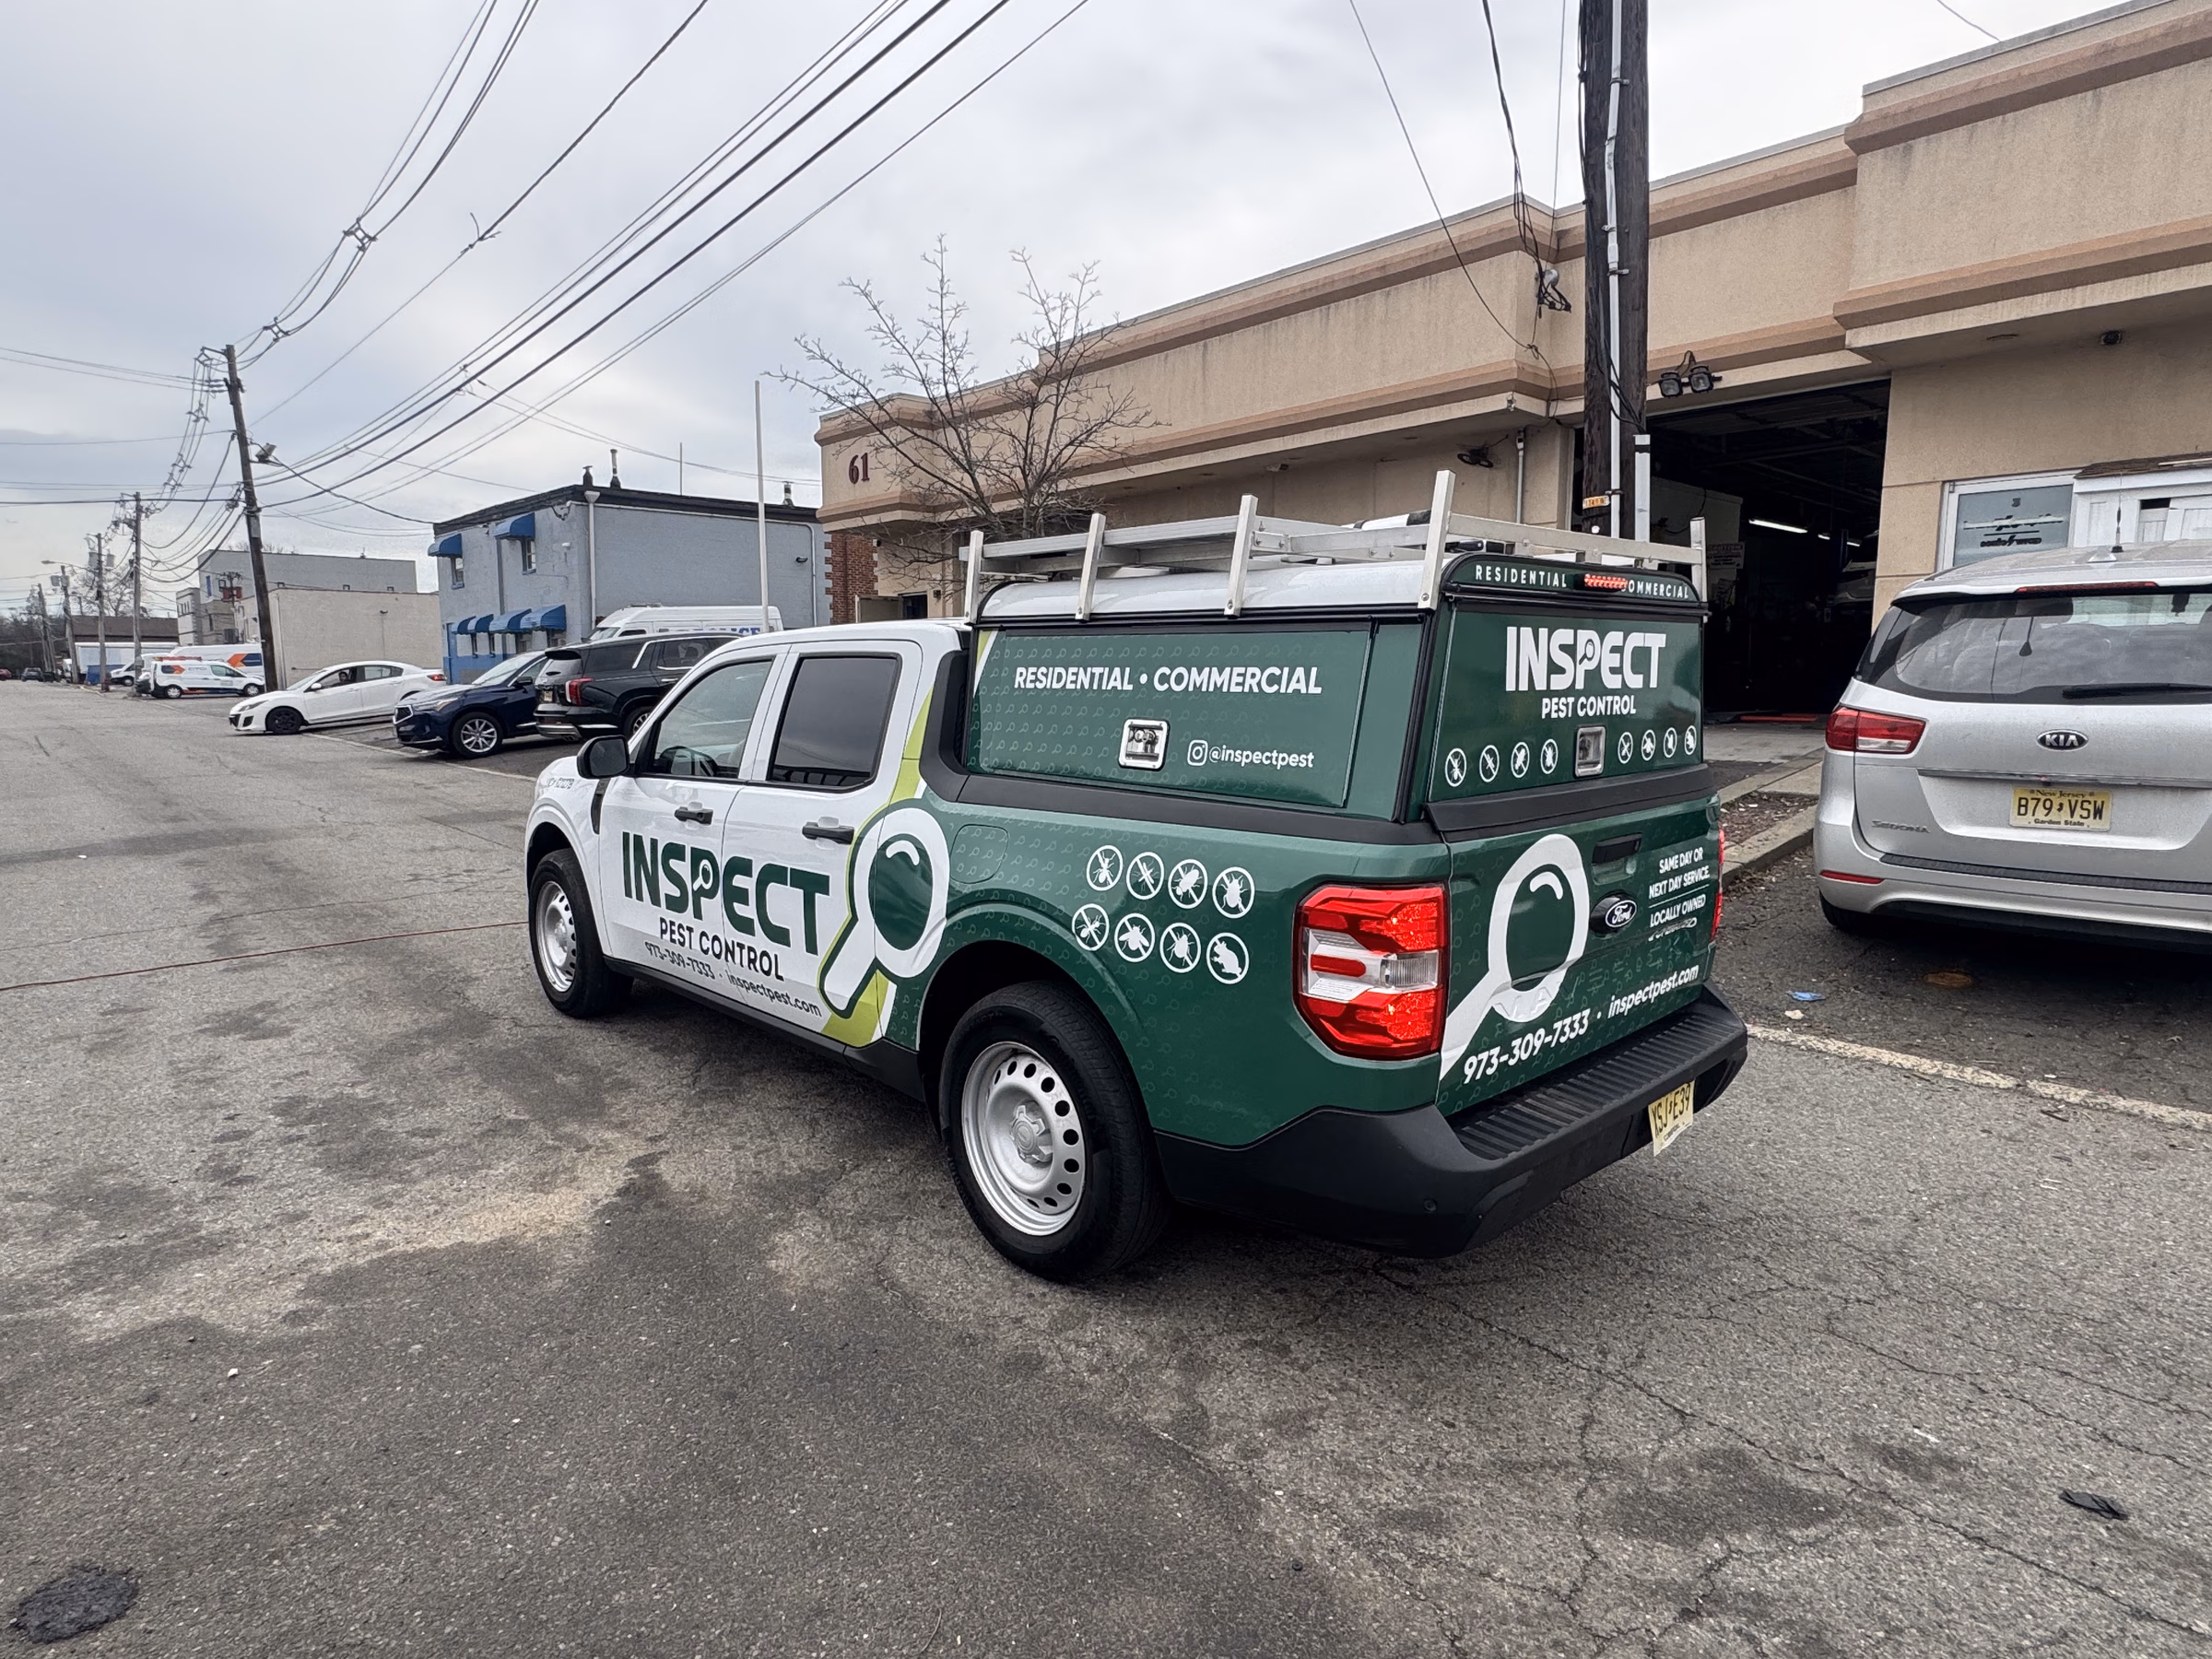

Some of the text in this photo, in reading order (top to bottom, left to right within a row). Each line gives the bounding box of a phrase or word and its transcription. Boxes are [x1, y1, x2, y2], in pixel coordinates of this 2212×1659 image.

[849, 453, 870, 485] 61
[1475, 564, 1567, 588] RESIDENTIAL
[1505, 626, 1666, 691] INSPECT
[1014, 665, 1323, 694] RESIDENTIAL COMMERCIAL
[1541, 695, 1636, 719] PEST CONTROL
[2045, 734, 2079, 747] KIA
[1208, 744, 1314, 771] @inspectpest
[2017, 796, 2105, 820] B79 VSW
[2036, 789, 2087, 799] New Jersey
[2033, 818, 2062, 826] Garden
[1659, 847, 1703, 874] SAME DAY OR
[622, 831, 830, 956] INSPECT
[1649, 865, 1710, 900] NEXT DAY SERVICE
[1612, 903, 1633, 924] Ford
[1650, 893, 1706, 928] LOCALLY OWNED
[659, 917, 784, 982] PEST CONTROL
[644, 941, 822, 1018] 973-309-7333 inspectpest.com
[1464, 1007, 1592, 1085] 973-309-7333
[1607, 964, 1700, 1018] inspectpest.com
[1673, 1082, 1691, 1122] E39
